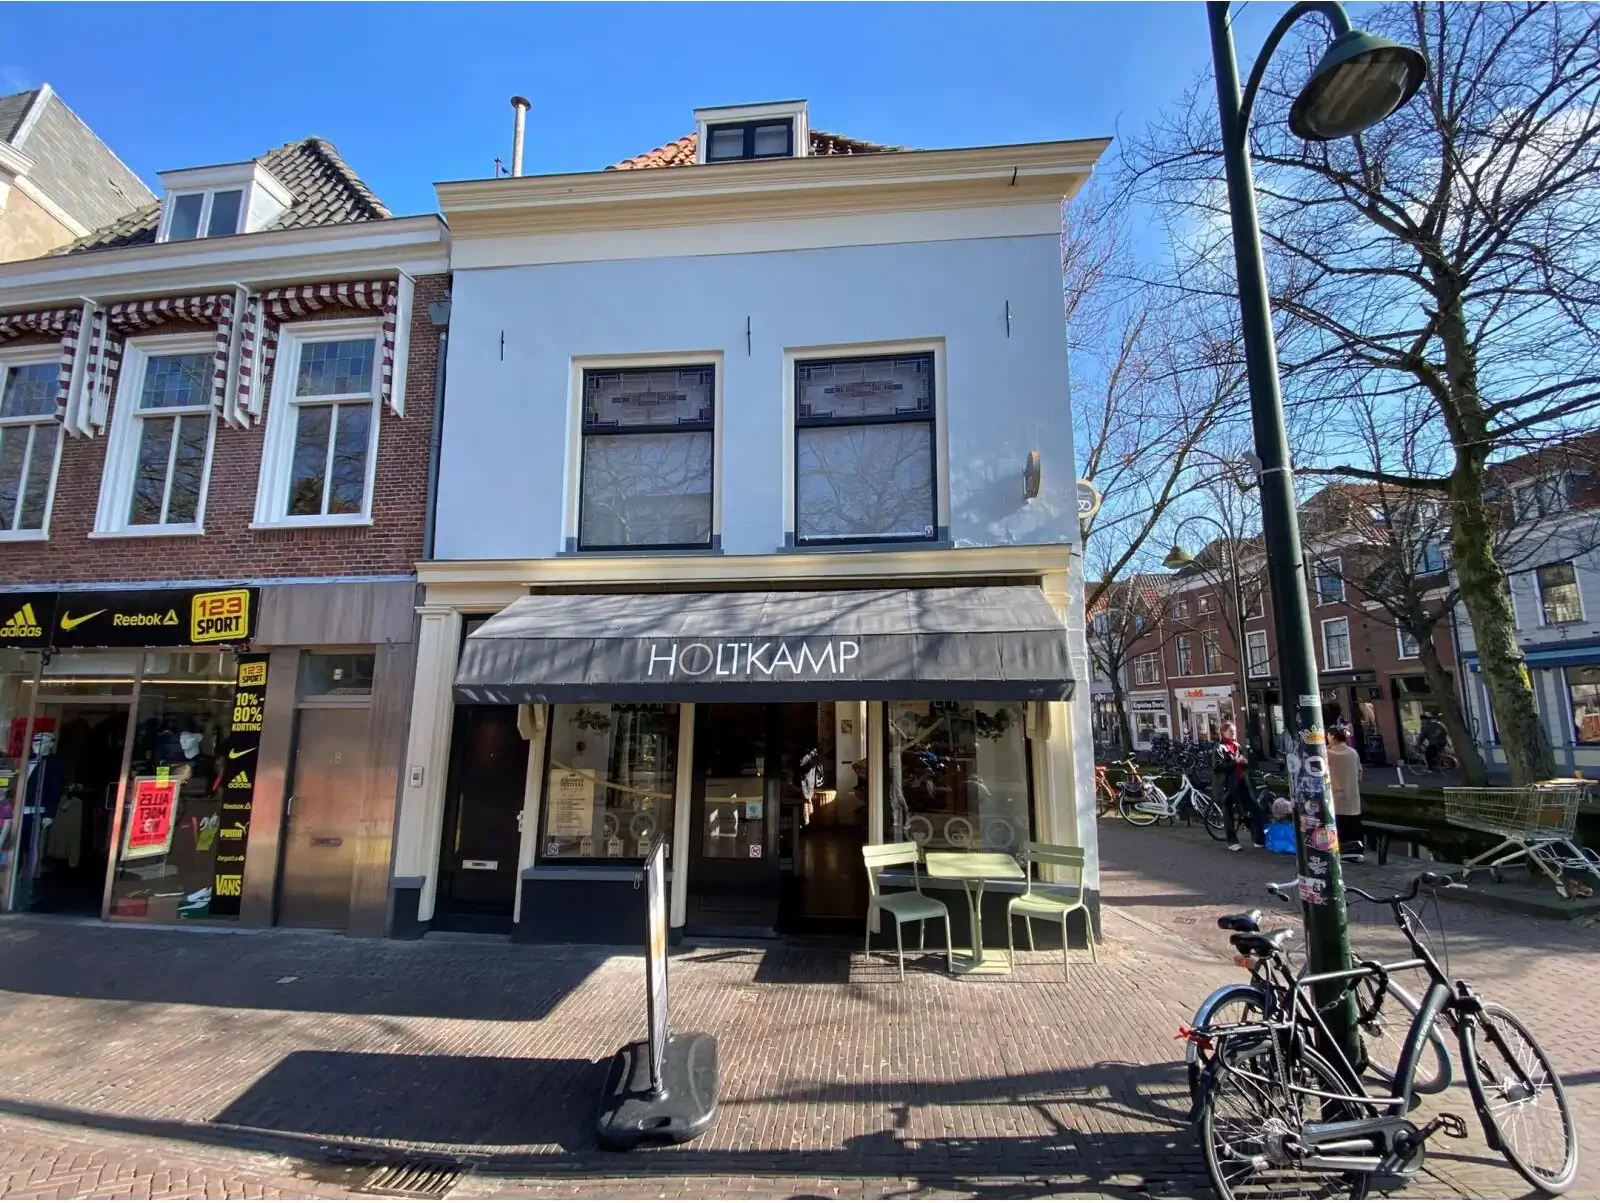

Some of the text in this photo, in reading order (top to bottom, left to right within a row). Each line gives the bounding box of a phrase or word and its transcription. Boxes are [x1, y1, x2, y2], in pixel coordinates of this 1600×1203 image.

[198, 596, 242, 616] 123
[113, 612, 162, 626] Reebok
[197, 615, 242, 636] SPORT
[0, 625, 42, 638] adidas
[648, 640, 860, 676] HOLTKAMP
[243, 665, 264, 675] 123
[242, 674, 262, 684] SPORT
[235, 692, 258, 706] 10%
[233, 706, 262, 722] 80%
[231, 722, 262, 732] KORTING
[220, 828, 243, 838] PUMA
[215, 874, 242, 896] VANS
